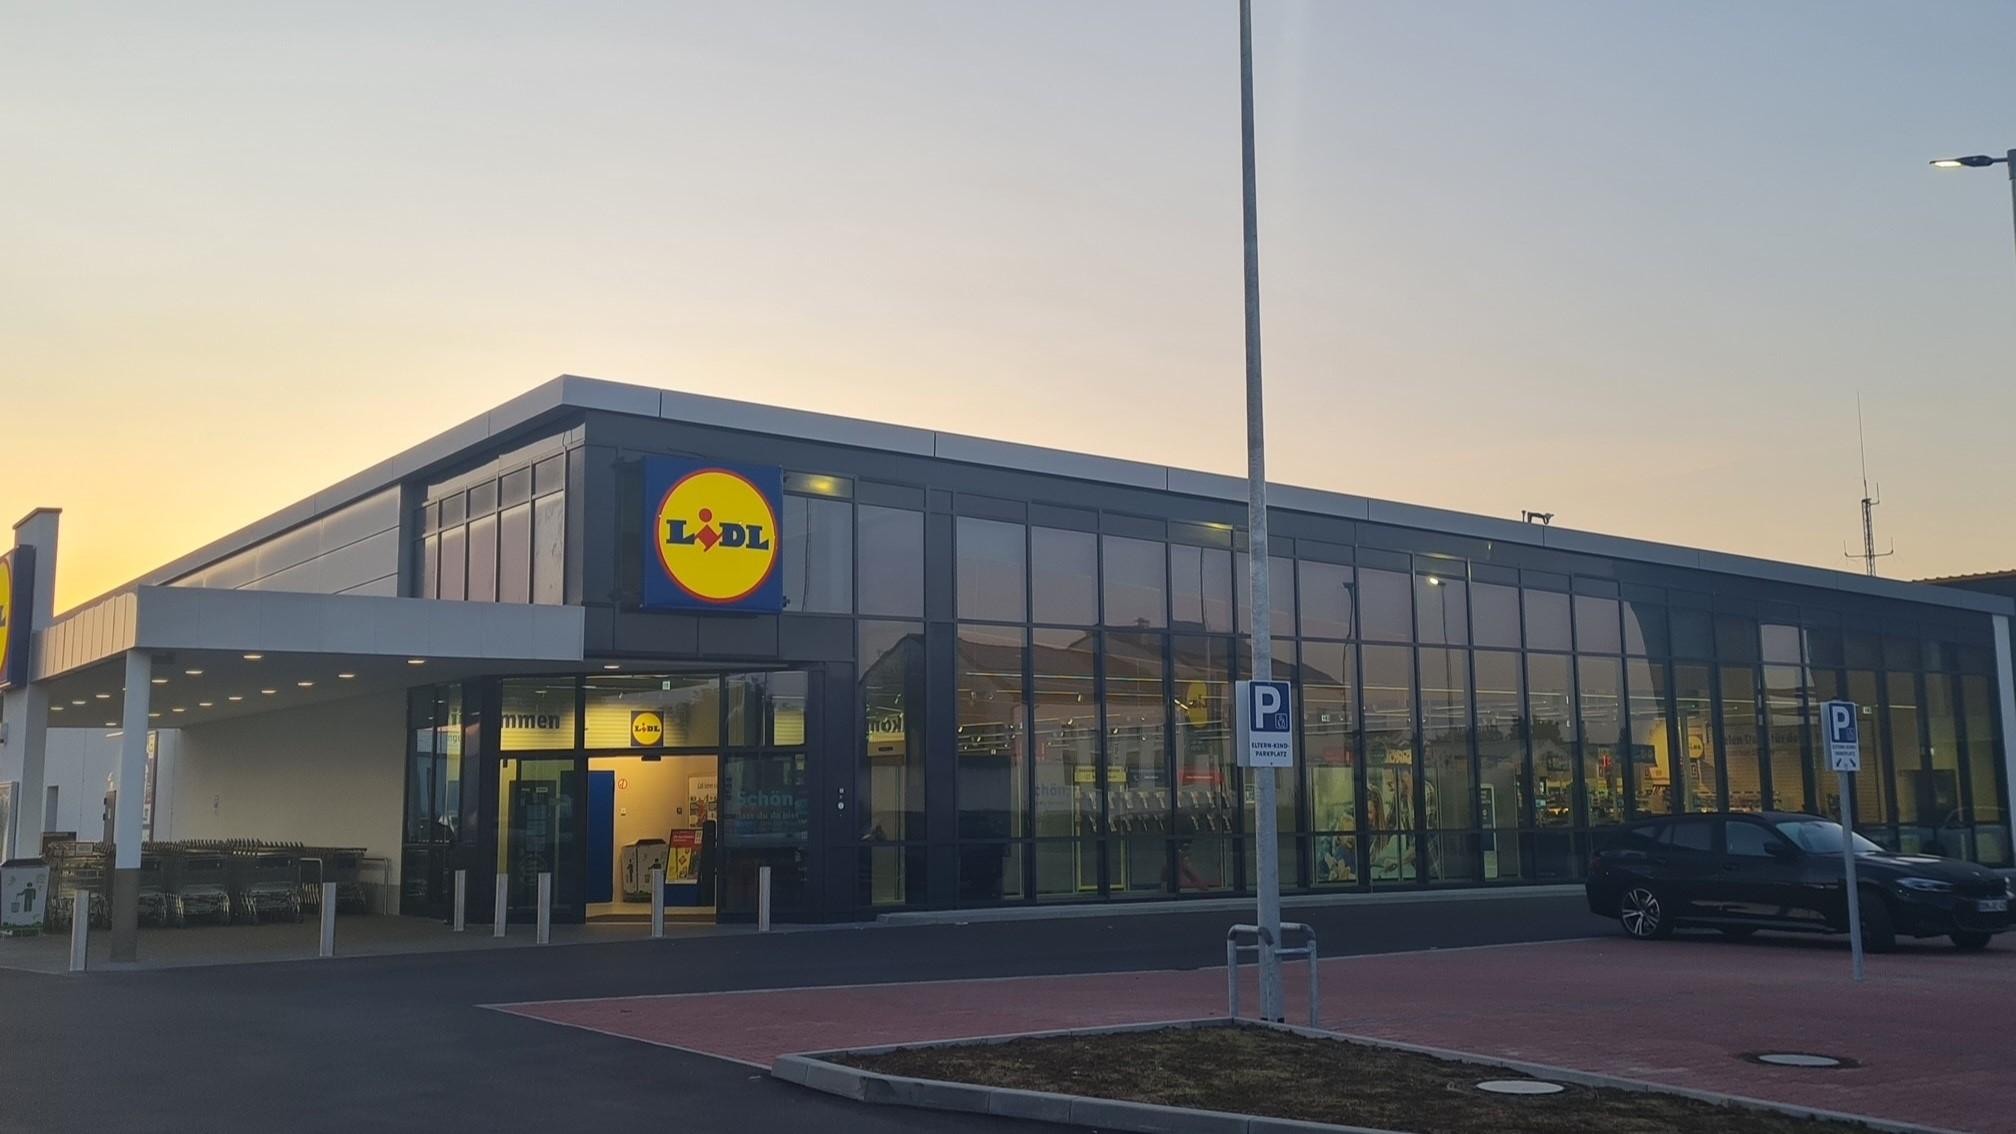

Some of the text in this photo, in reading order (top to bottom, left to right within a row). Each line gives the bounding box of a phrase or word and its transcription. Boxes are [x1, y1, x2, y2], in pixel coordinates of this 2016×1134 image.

[666, 508, 769, 552] LIDL
[1254, 685, 1281, 729] P
[1832, 705, 1850, 741] P
[634, 722, 661, 734] LIDL
